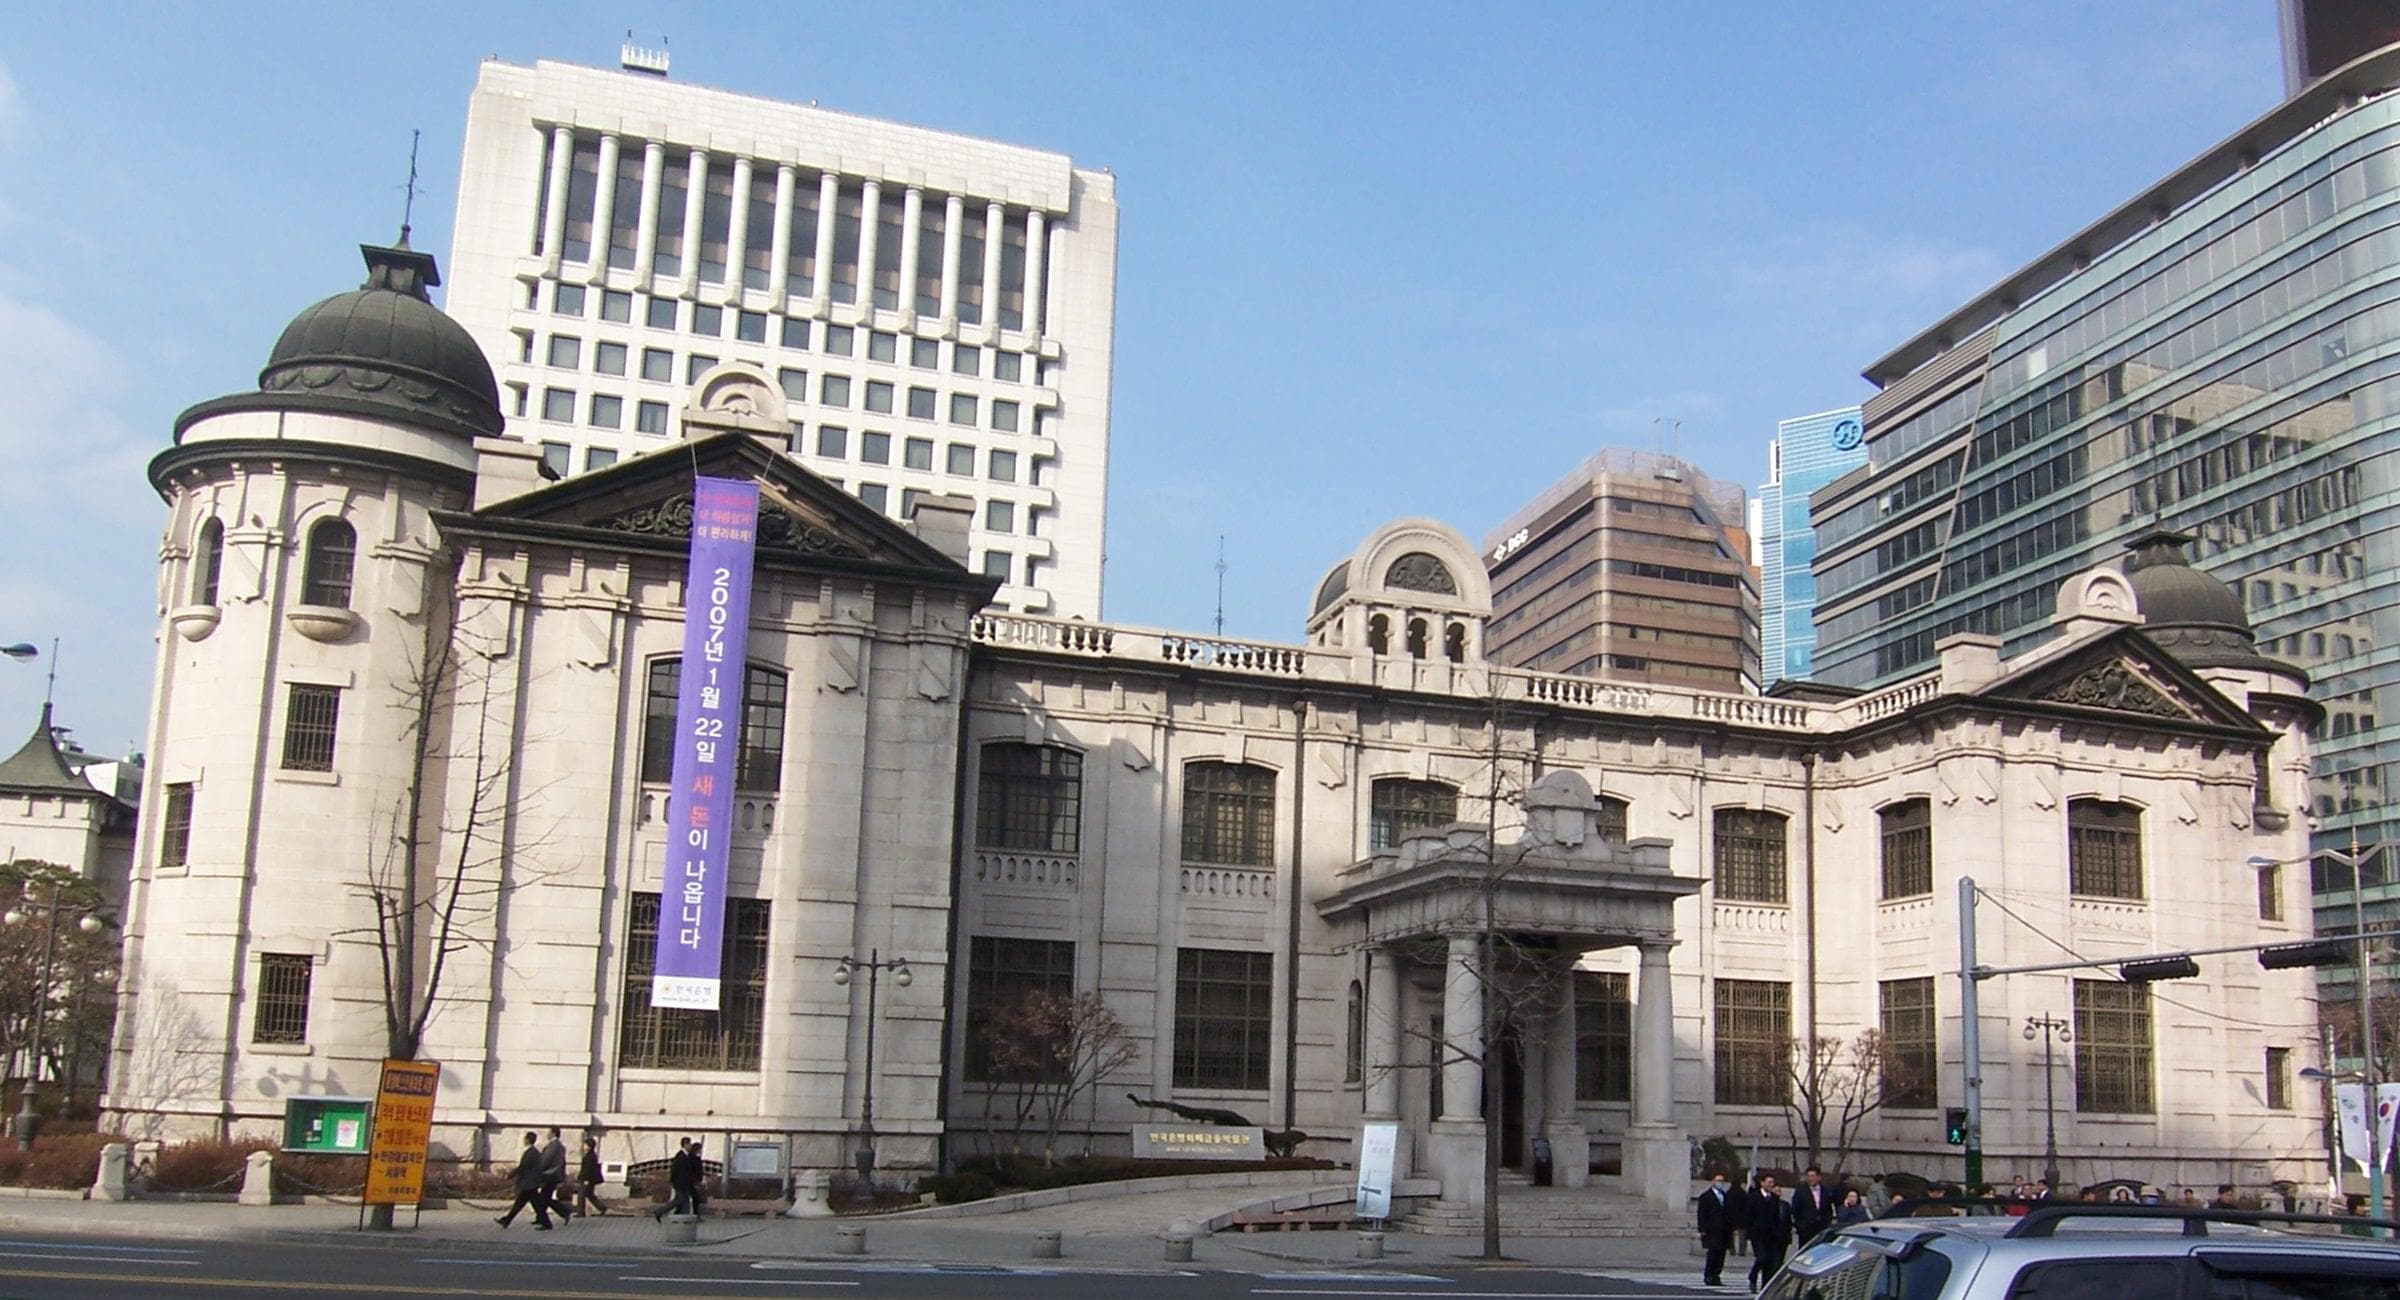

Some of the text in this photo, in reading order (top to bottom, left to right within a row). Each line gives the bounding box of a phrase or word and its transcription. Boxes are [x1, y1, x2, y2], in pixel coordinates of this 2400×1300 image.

[680, 567, 731, 949] 2007년 1월 22일 새 돈이 나옵니다
